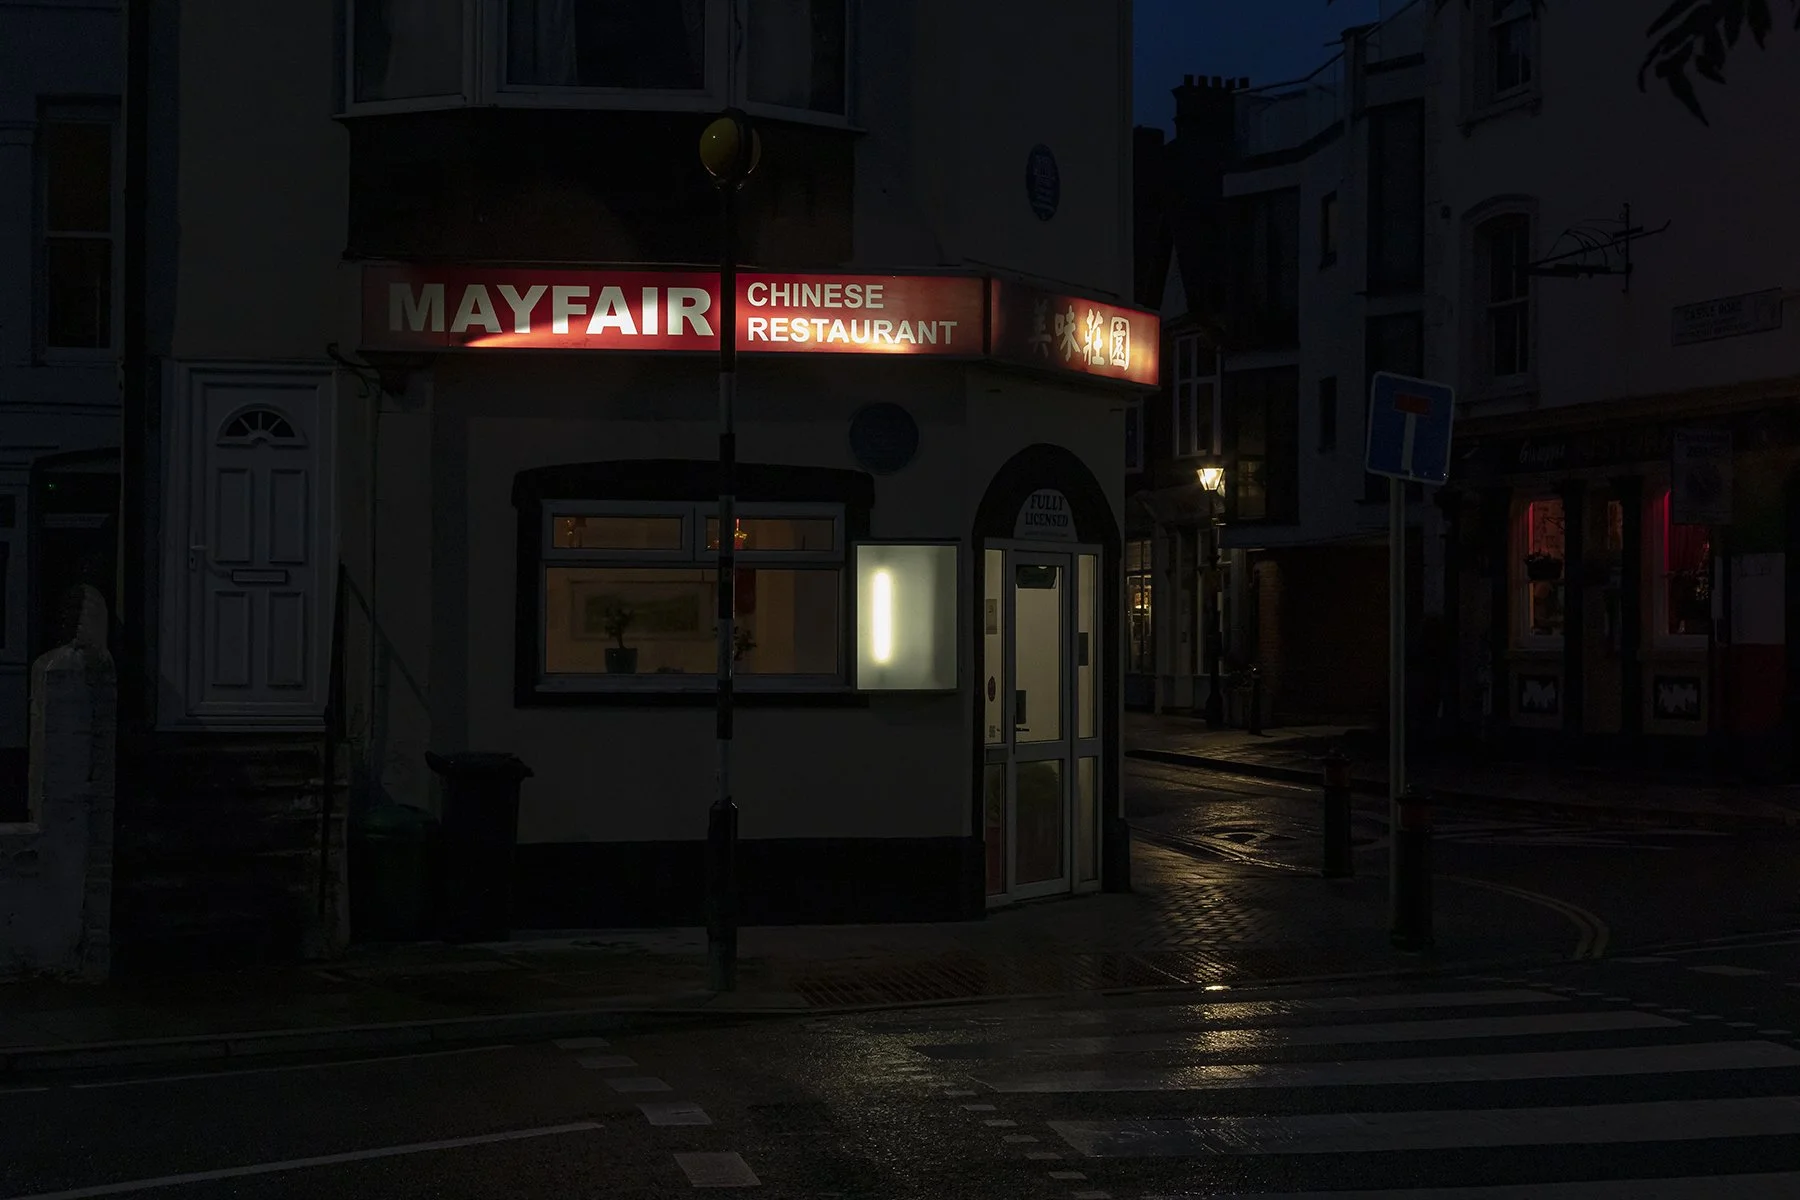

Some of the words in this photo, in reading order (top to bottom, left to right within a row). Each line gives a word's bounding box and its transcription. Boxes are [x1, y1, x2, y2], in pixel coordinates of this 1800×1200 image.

[747, 282, 885, 308] CHINESE
[389, 283, 714, 336] MAYFAIR
[748, 317, 958, 344] RESTAURANT
[1030, 494, 1064, 510] FULLY
[1025, 512, 1069, 527] LICENSED
